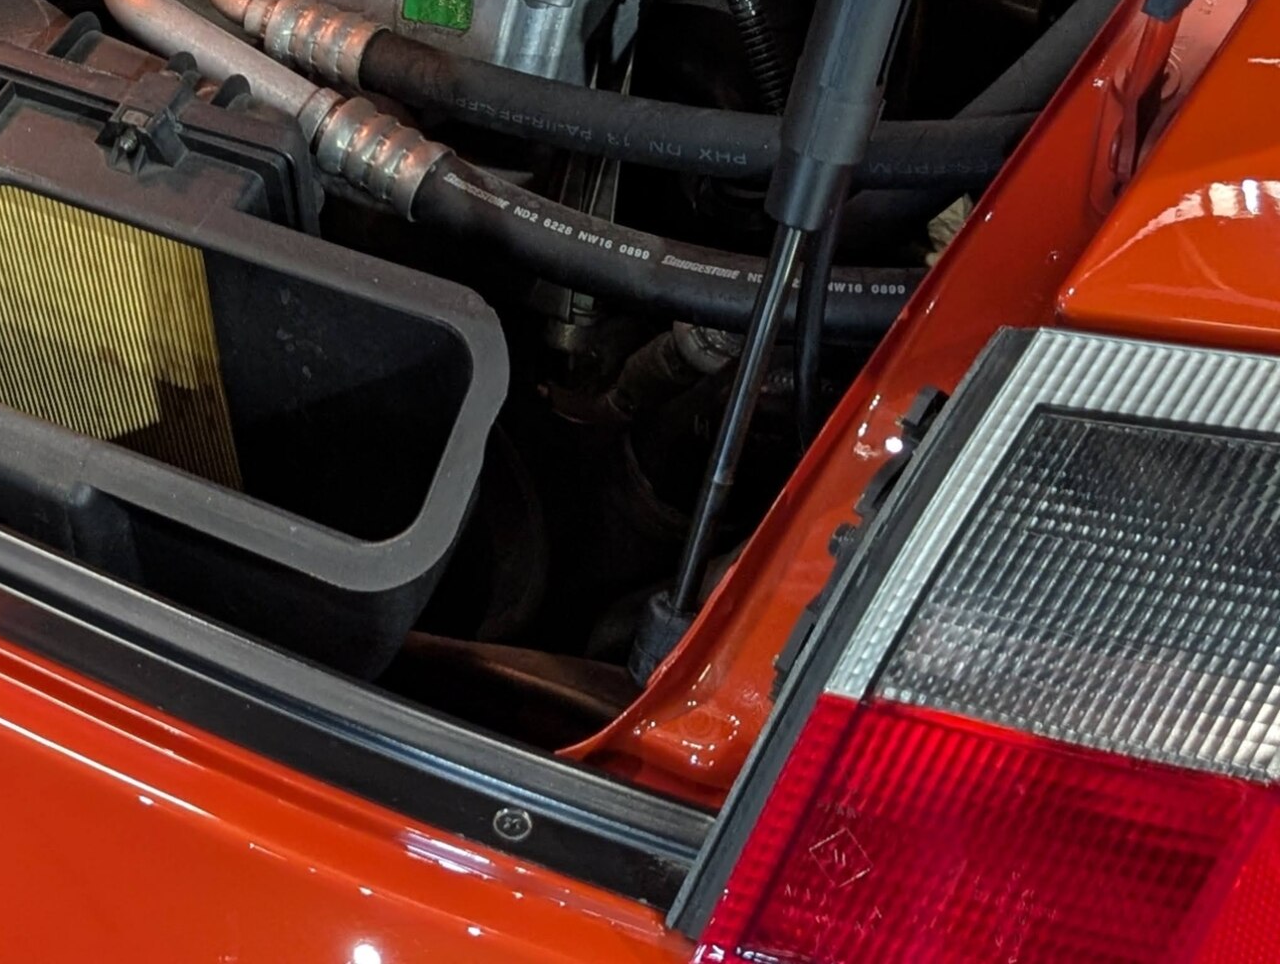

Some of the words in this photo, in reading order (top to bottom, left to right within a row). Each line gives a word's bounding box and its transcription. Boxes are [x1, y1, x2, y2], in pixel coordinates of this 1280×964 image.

[648, 140, 682, 156] DN
[699, 147, 747, 165] PHX
[514, 206, 539, 223] ND2
[543, 218, 573, 236] 6228
[578, 230, 613, 250] NW16
[618, 244, 651, 260] 0899
[661, 254, 741, 280] BRIDGESTONE
